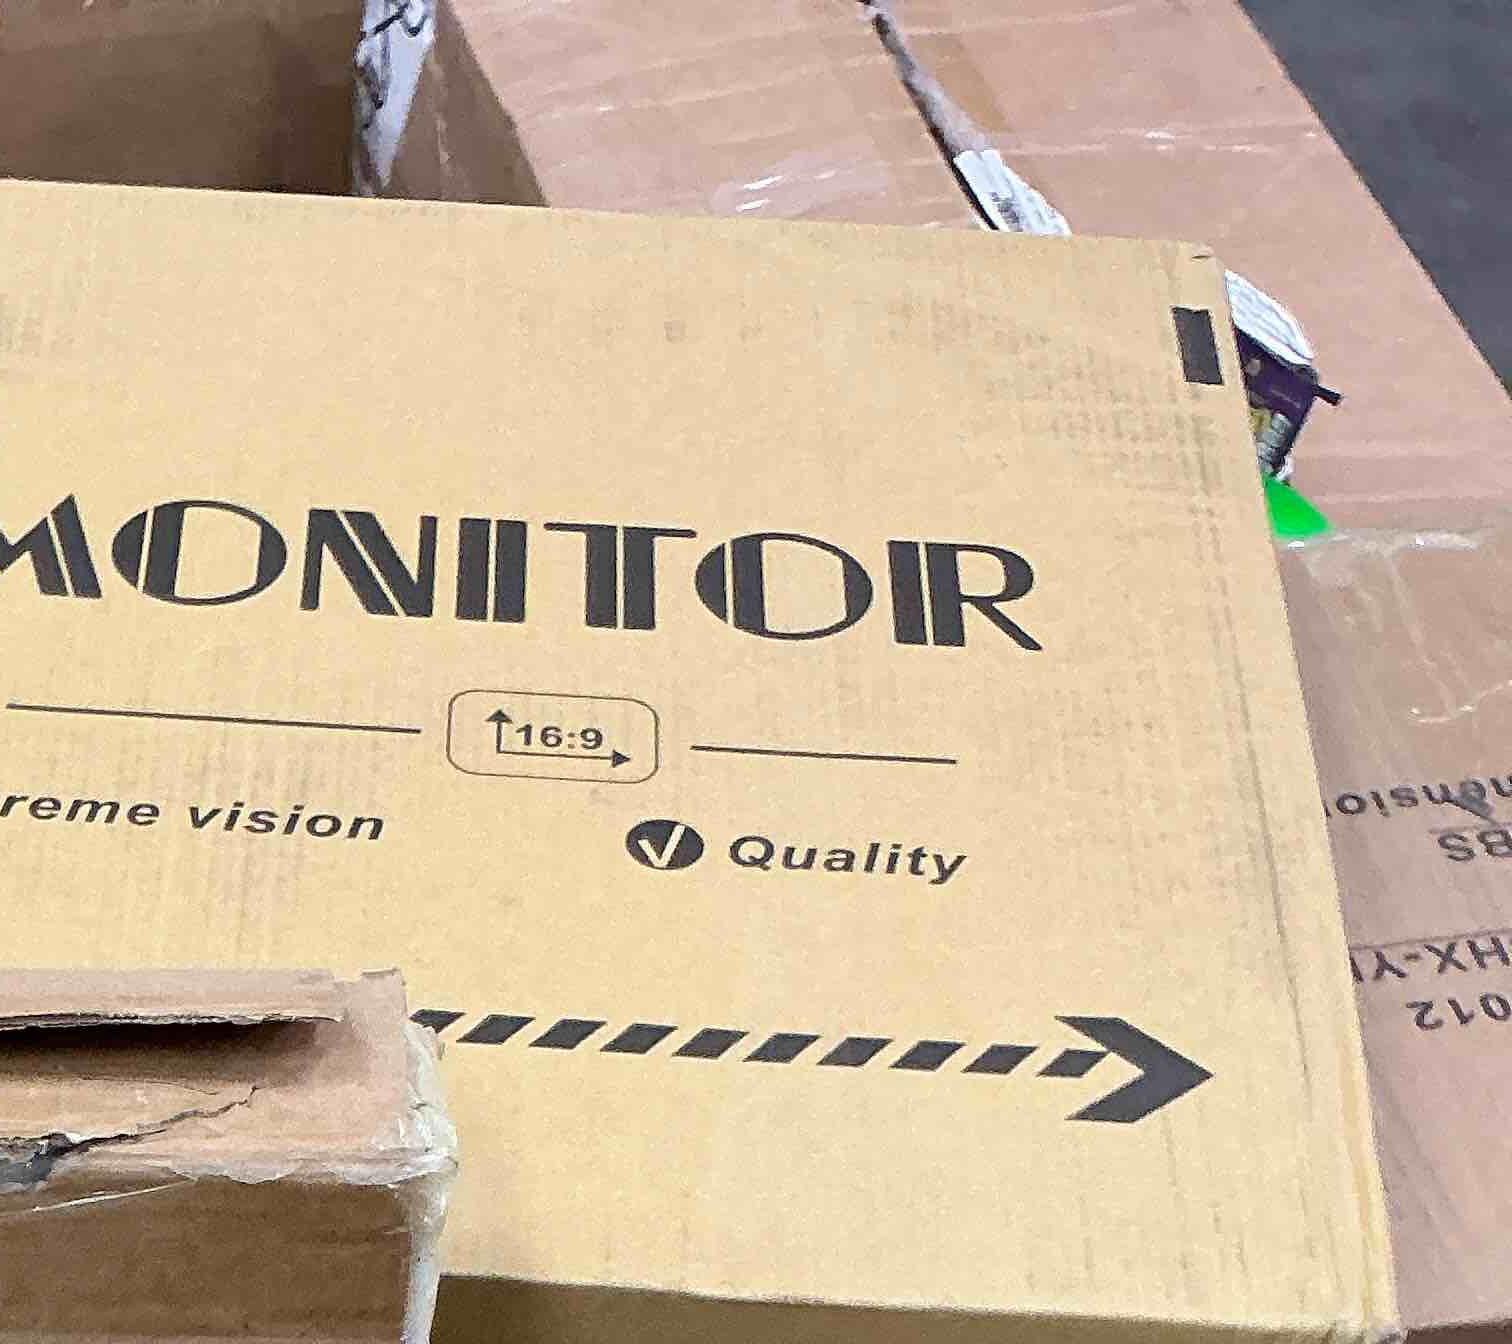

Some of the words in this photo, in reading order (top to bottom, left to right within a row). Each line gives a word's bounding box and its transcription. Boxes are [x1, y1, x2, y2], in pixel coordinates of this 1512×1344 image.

[514, 724, 604, 752] 16:9
[188, 800, 386, 842] vision
[729, 834, 968, 886] Quality
